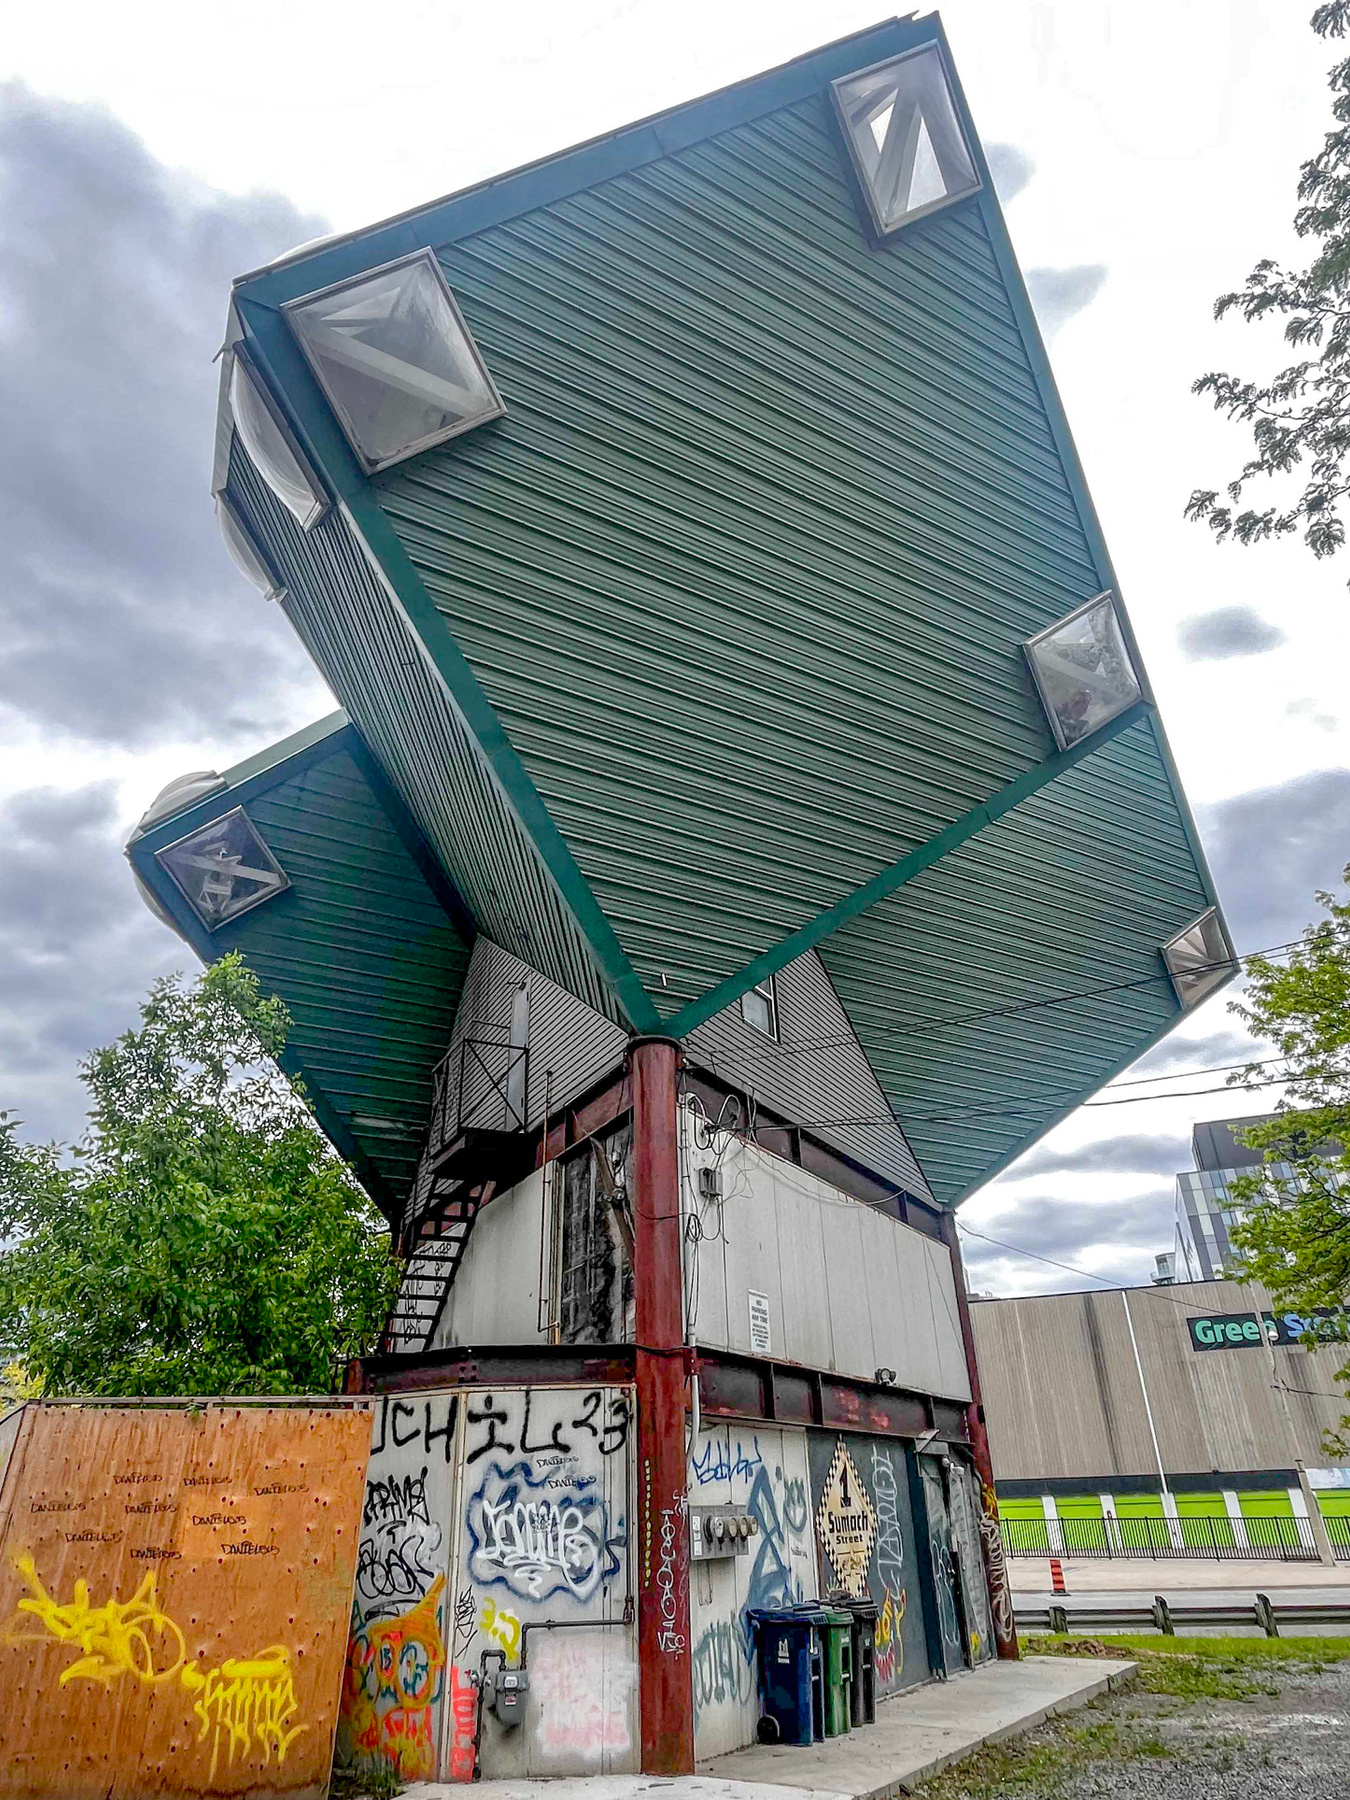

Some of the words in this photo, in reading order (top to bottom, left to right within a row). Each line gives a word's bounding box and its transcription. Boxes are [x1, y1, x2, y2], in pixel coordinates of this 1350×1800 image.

[839, 1463, 851, 1508] 1
[827, 1510, 869, 1535] Sumach
[835, 1533, 864, 1545] Street
